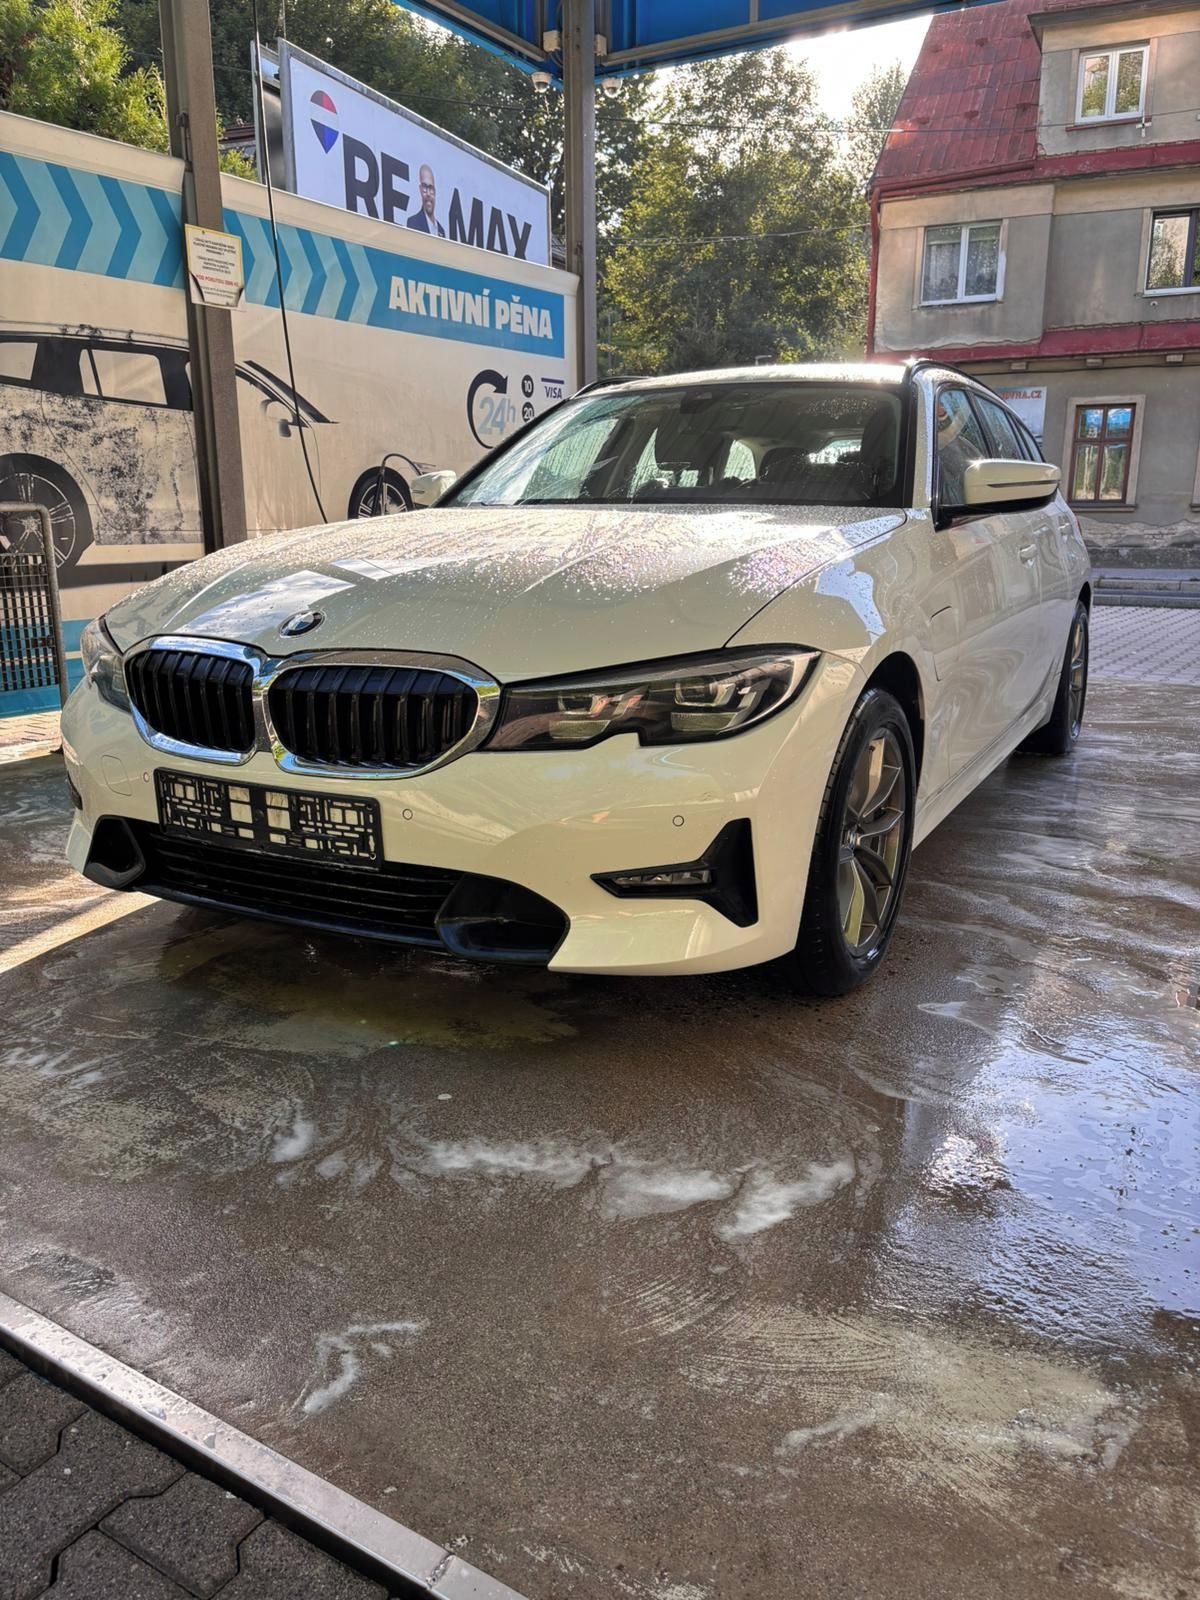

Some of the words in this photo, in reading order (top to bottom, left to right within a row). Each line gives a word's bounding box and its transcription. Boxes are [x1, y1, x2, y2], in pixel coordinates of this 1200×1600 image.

[449, 187, 532, 260] MAX
[389, 276, 490, 327] AKTIVNÍ
[495, 295, 553, 340] PĚNA
[479, 397, 516, 434] 24h
[544, 386, 563, 399] VISA
